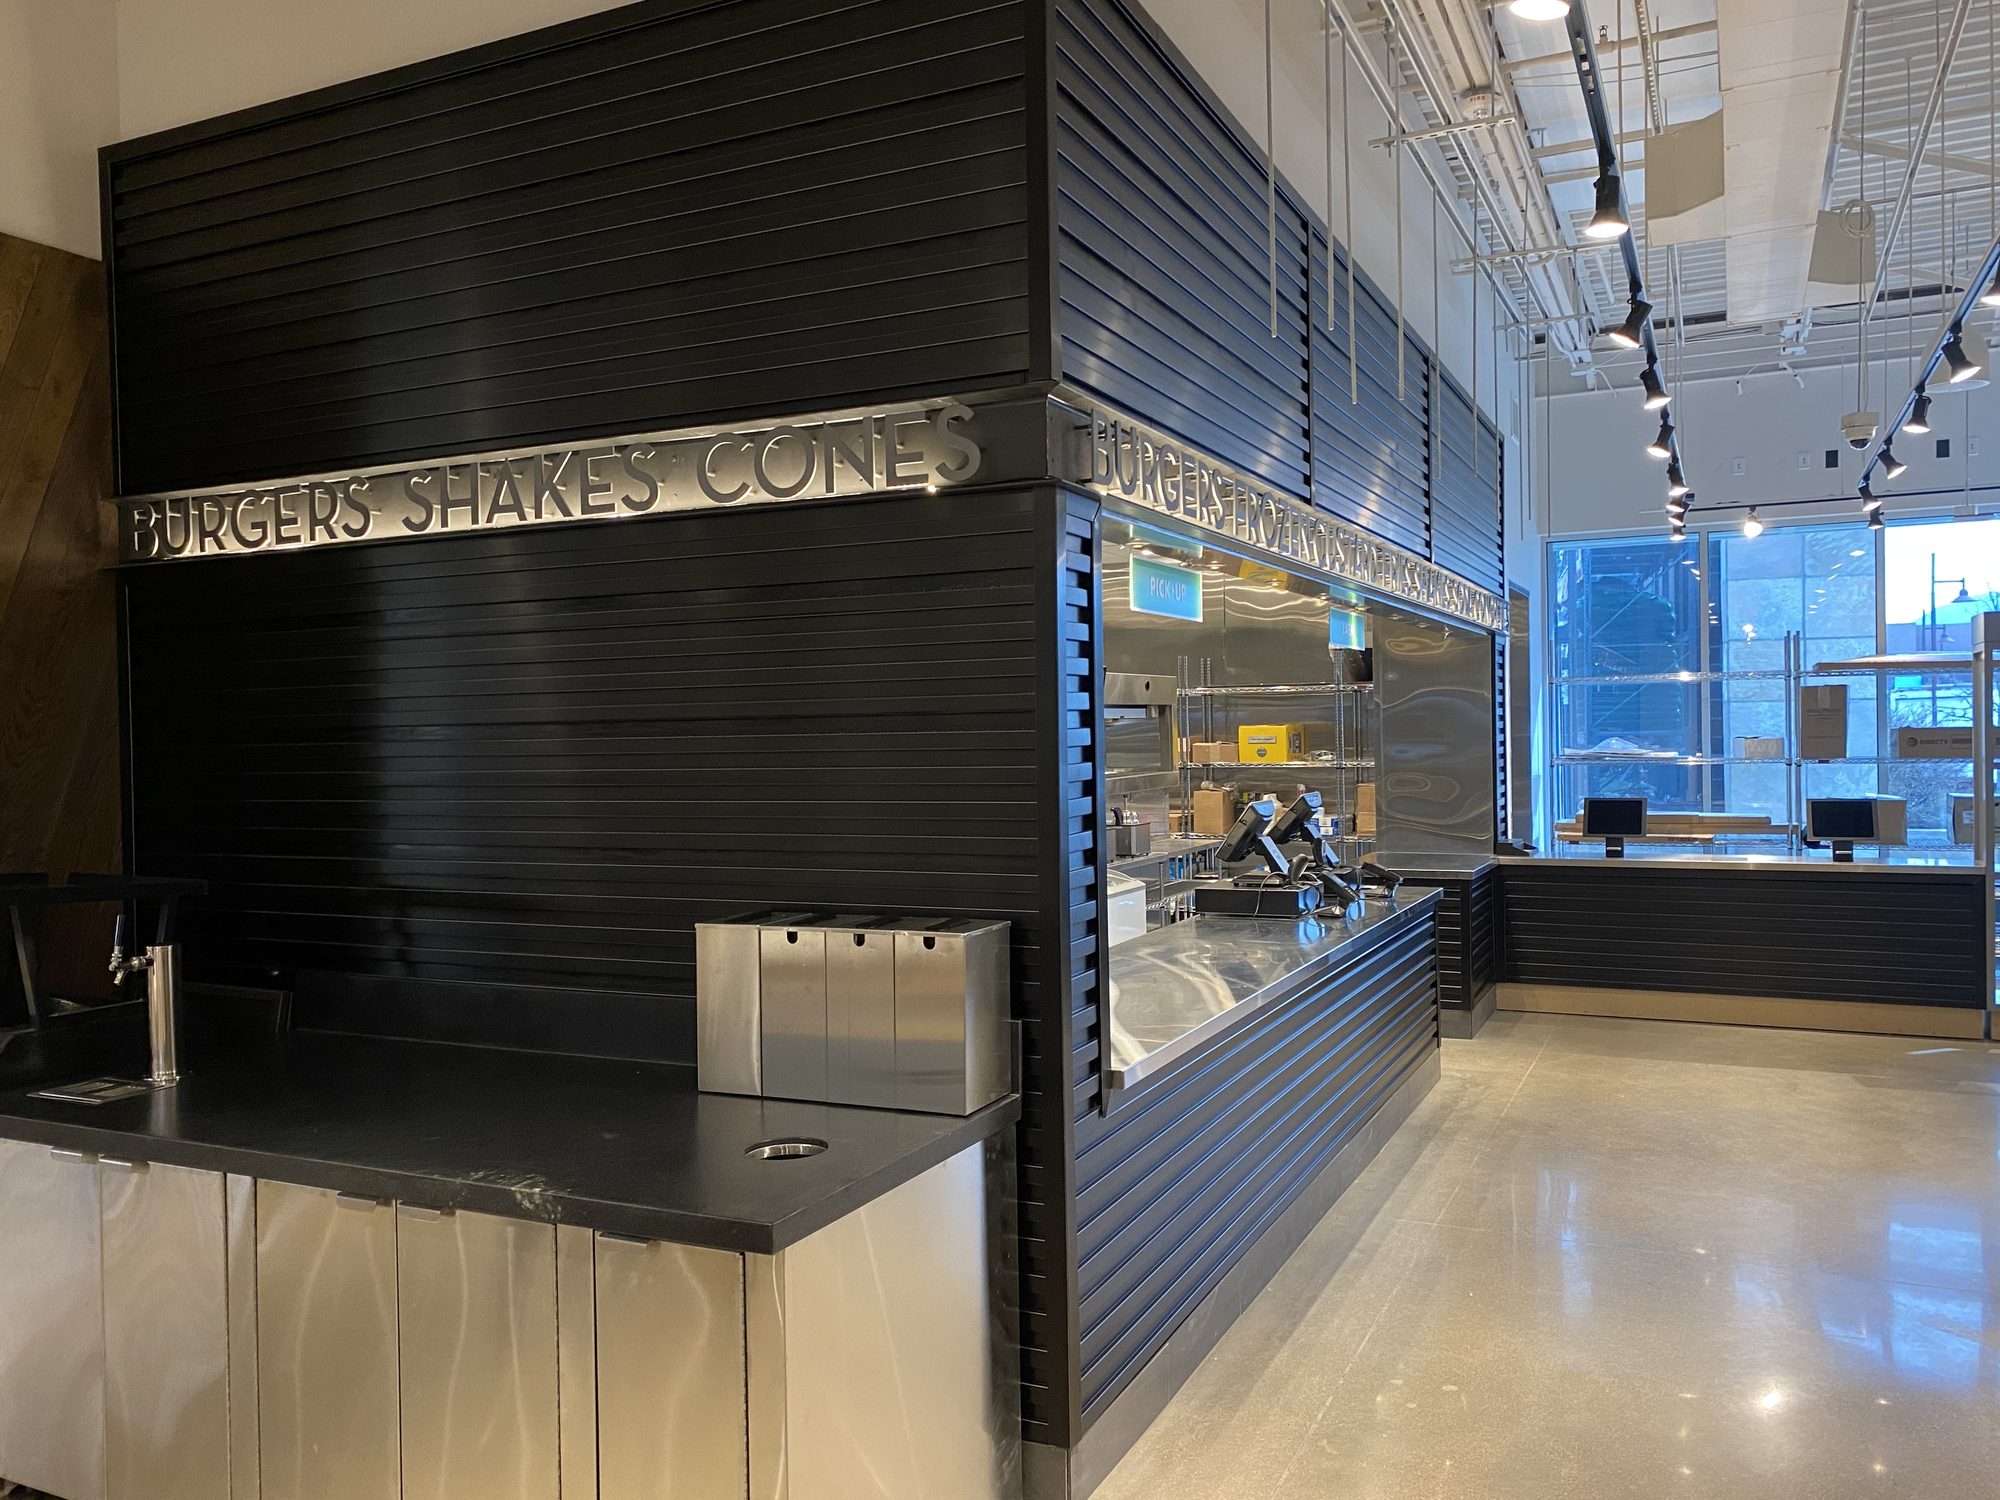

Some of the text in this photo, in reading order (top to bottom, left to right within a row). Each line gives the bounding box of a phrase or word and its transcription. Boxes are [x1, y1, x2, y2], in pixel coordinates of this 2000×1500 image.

[131, 404, 981, 558] BURGERS SHAKES CONES
[1091, 409, 1226, 530] BURGERS
[1232, 478, 1311, 563] FROZEN
